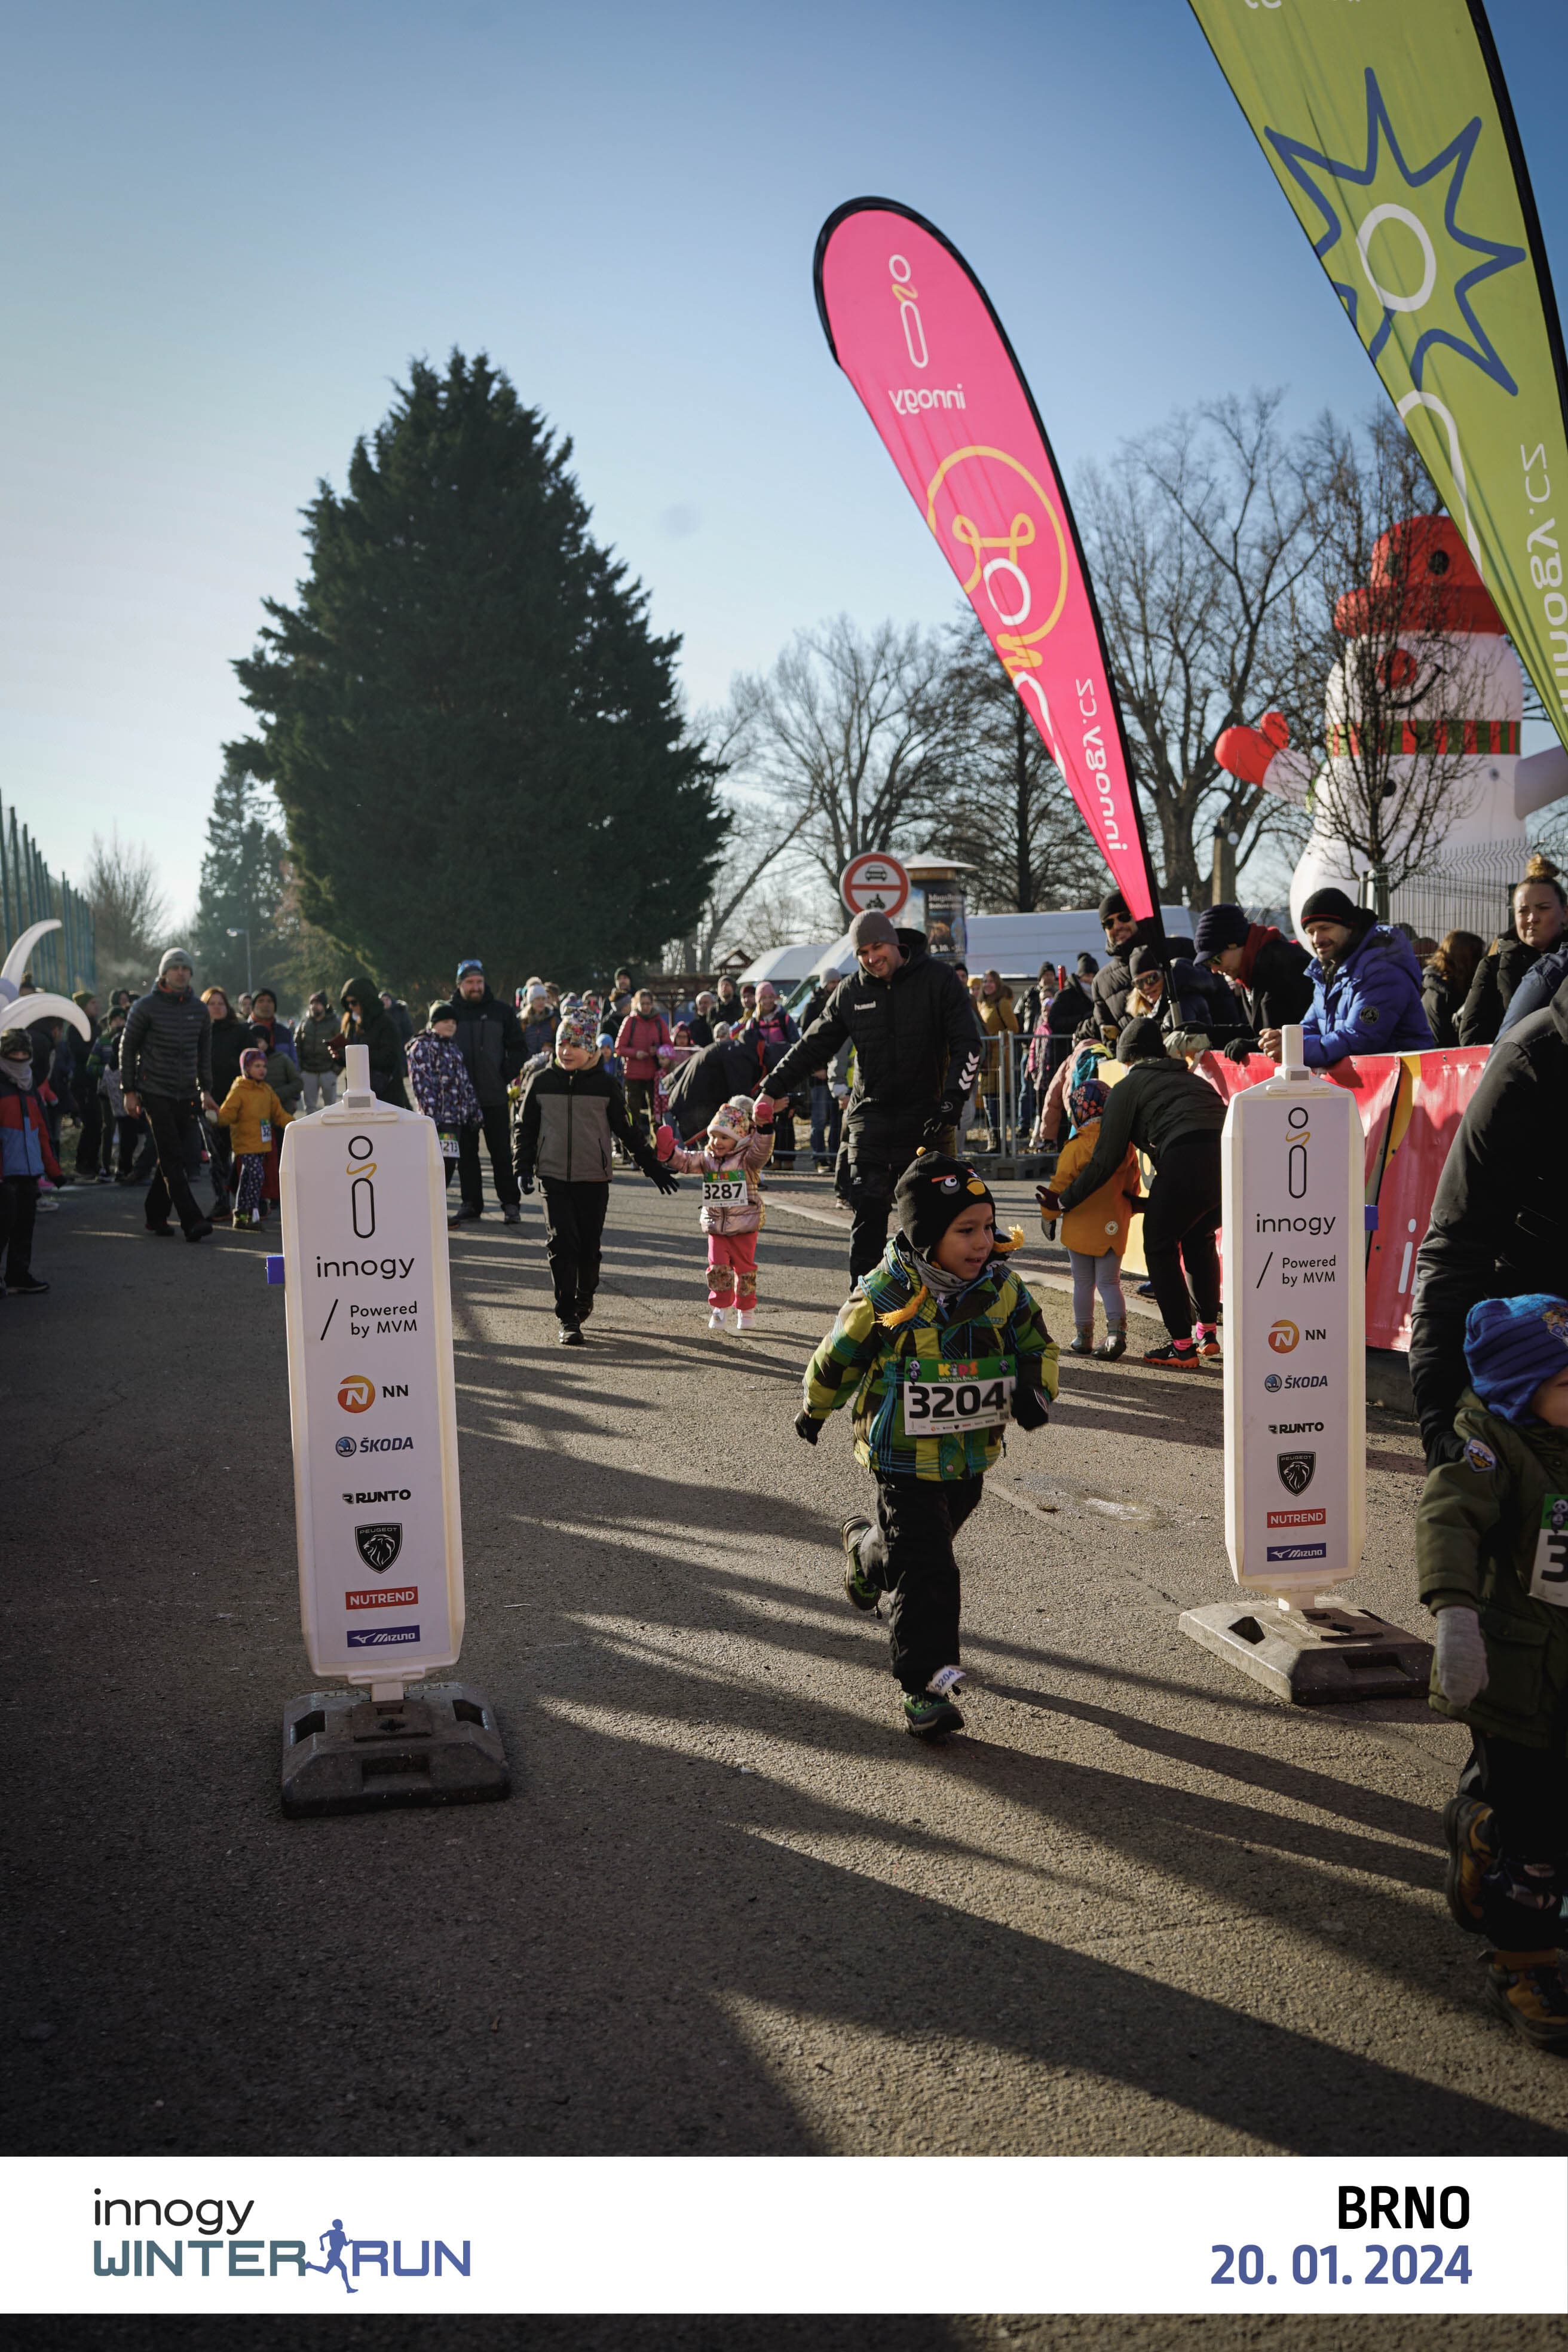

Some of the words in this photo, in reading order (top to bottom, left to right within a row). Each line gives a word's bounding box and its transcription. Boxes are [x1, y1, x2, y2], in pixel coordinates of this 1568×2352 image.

[704, 1183, 742, 1200] 3287
[1256, 1213, 1336, 1235] innogy
[316, 1256, 415, 1279] innogy
[1282, 1255, 1336, 1268] Powered
[1282, 1273, 1298, 1287] by
[1303, 1271, 1335, 1283] MVM
[350, 1301, 417, 1317] Powered
[351, 1322, 369, 1338] by
[377, 1319, 417, 1334] MVM
[1305, 1329, 1326, 1340] NN
[1284, 1375, 1328, 1389] ŠKODA
[382, 1384, 409, 1398] NN
[908, 1382, 1007, 1419] 3204
[1279, 1422, 1324, 1434] RUNTO
[359, 1437, 414, 1453] ŠKODA
[356, 1489, 411, 1504] RUNTO
[1270, 1512, 1323, 1524] NUTREND
[350, 1591, 415, 1606] NUTREND
[935, 1670, 955, 1691] 3204
